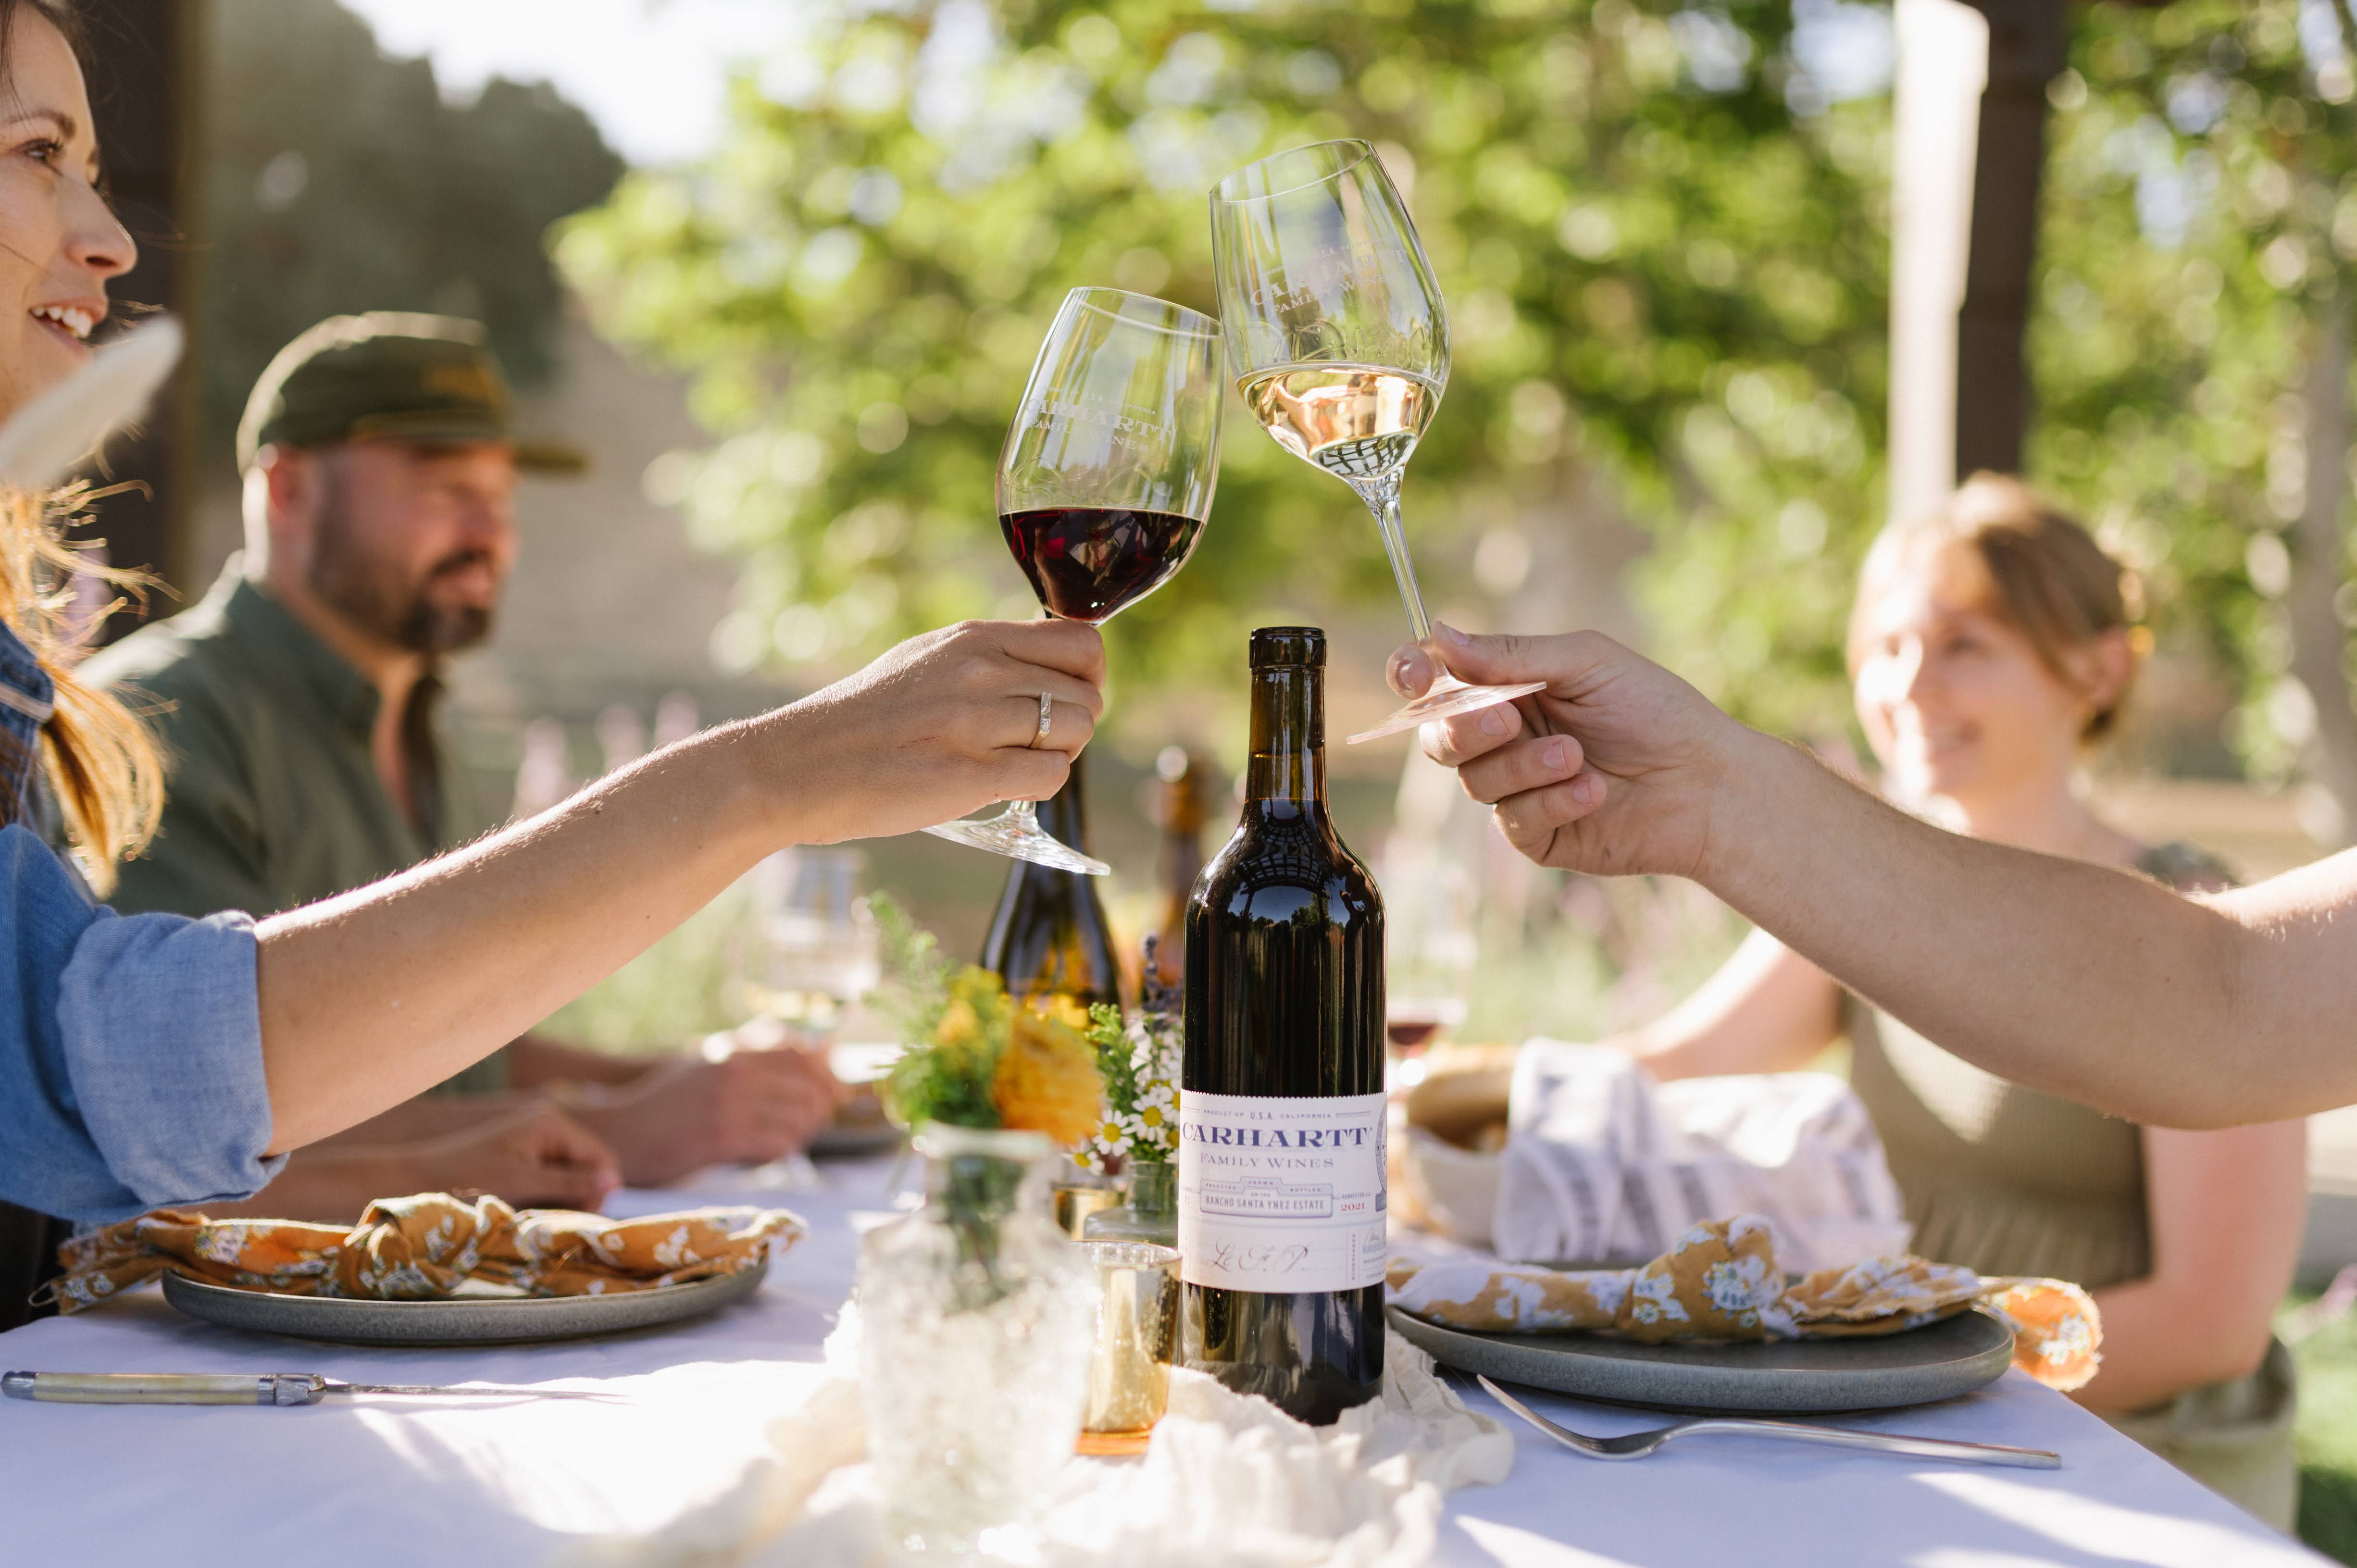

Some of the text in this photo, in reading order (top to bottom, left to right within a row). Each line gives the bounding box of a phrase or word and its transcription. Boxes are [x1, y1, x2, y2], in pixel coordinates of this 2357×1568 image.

[1182, 1122, 1368, 1147] CARHARTT
[1200, 1153, 1334, 1169] FAMILY WINES
[1206, 1195, 1324, 1210] RANCHO SANTA YNEZ ESTATE
[1340, 1202, 1365, 1212] 2021
